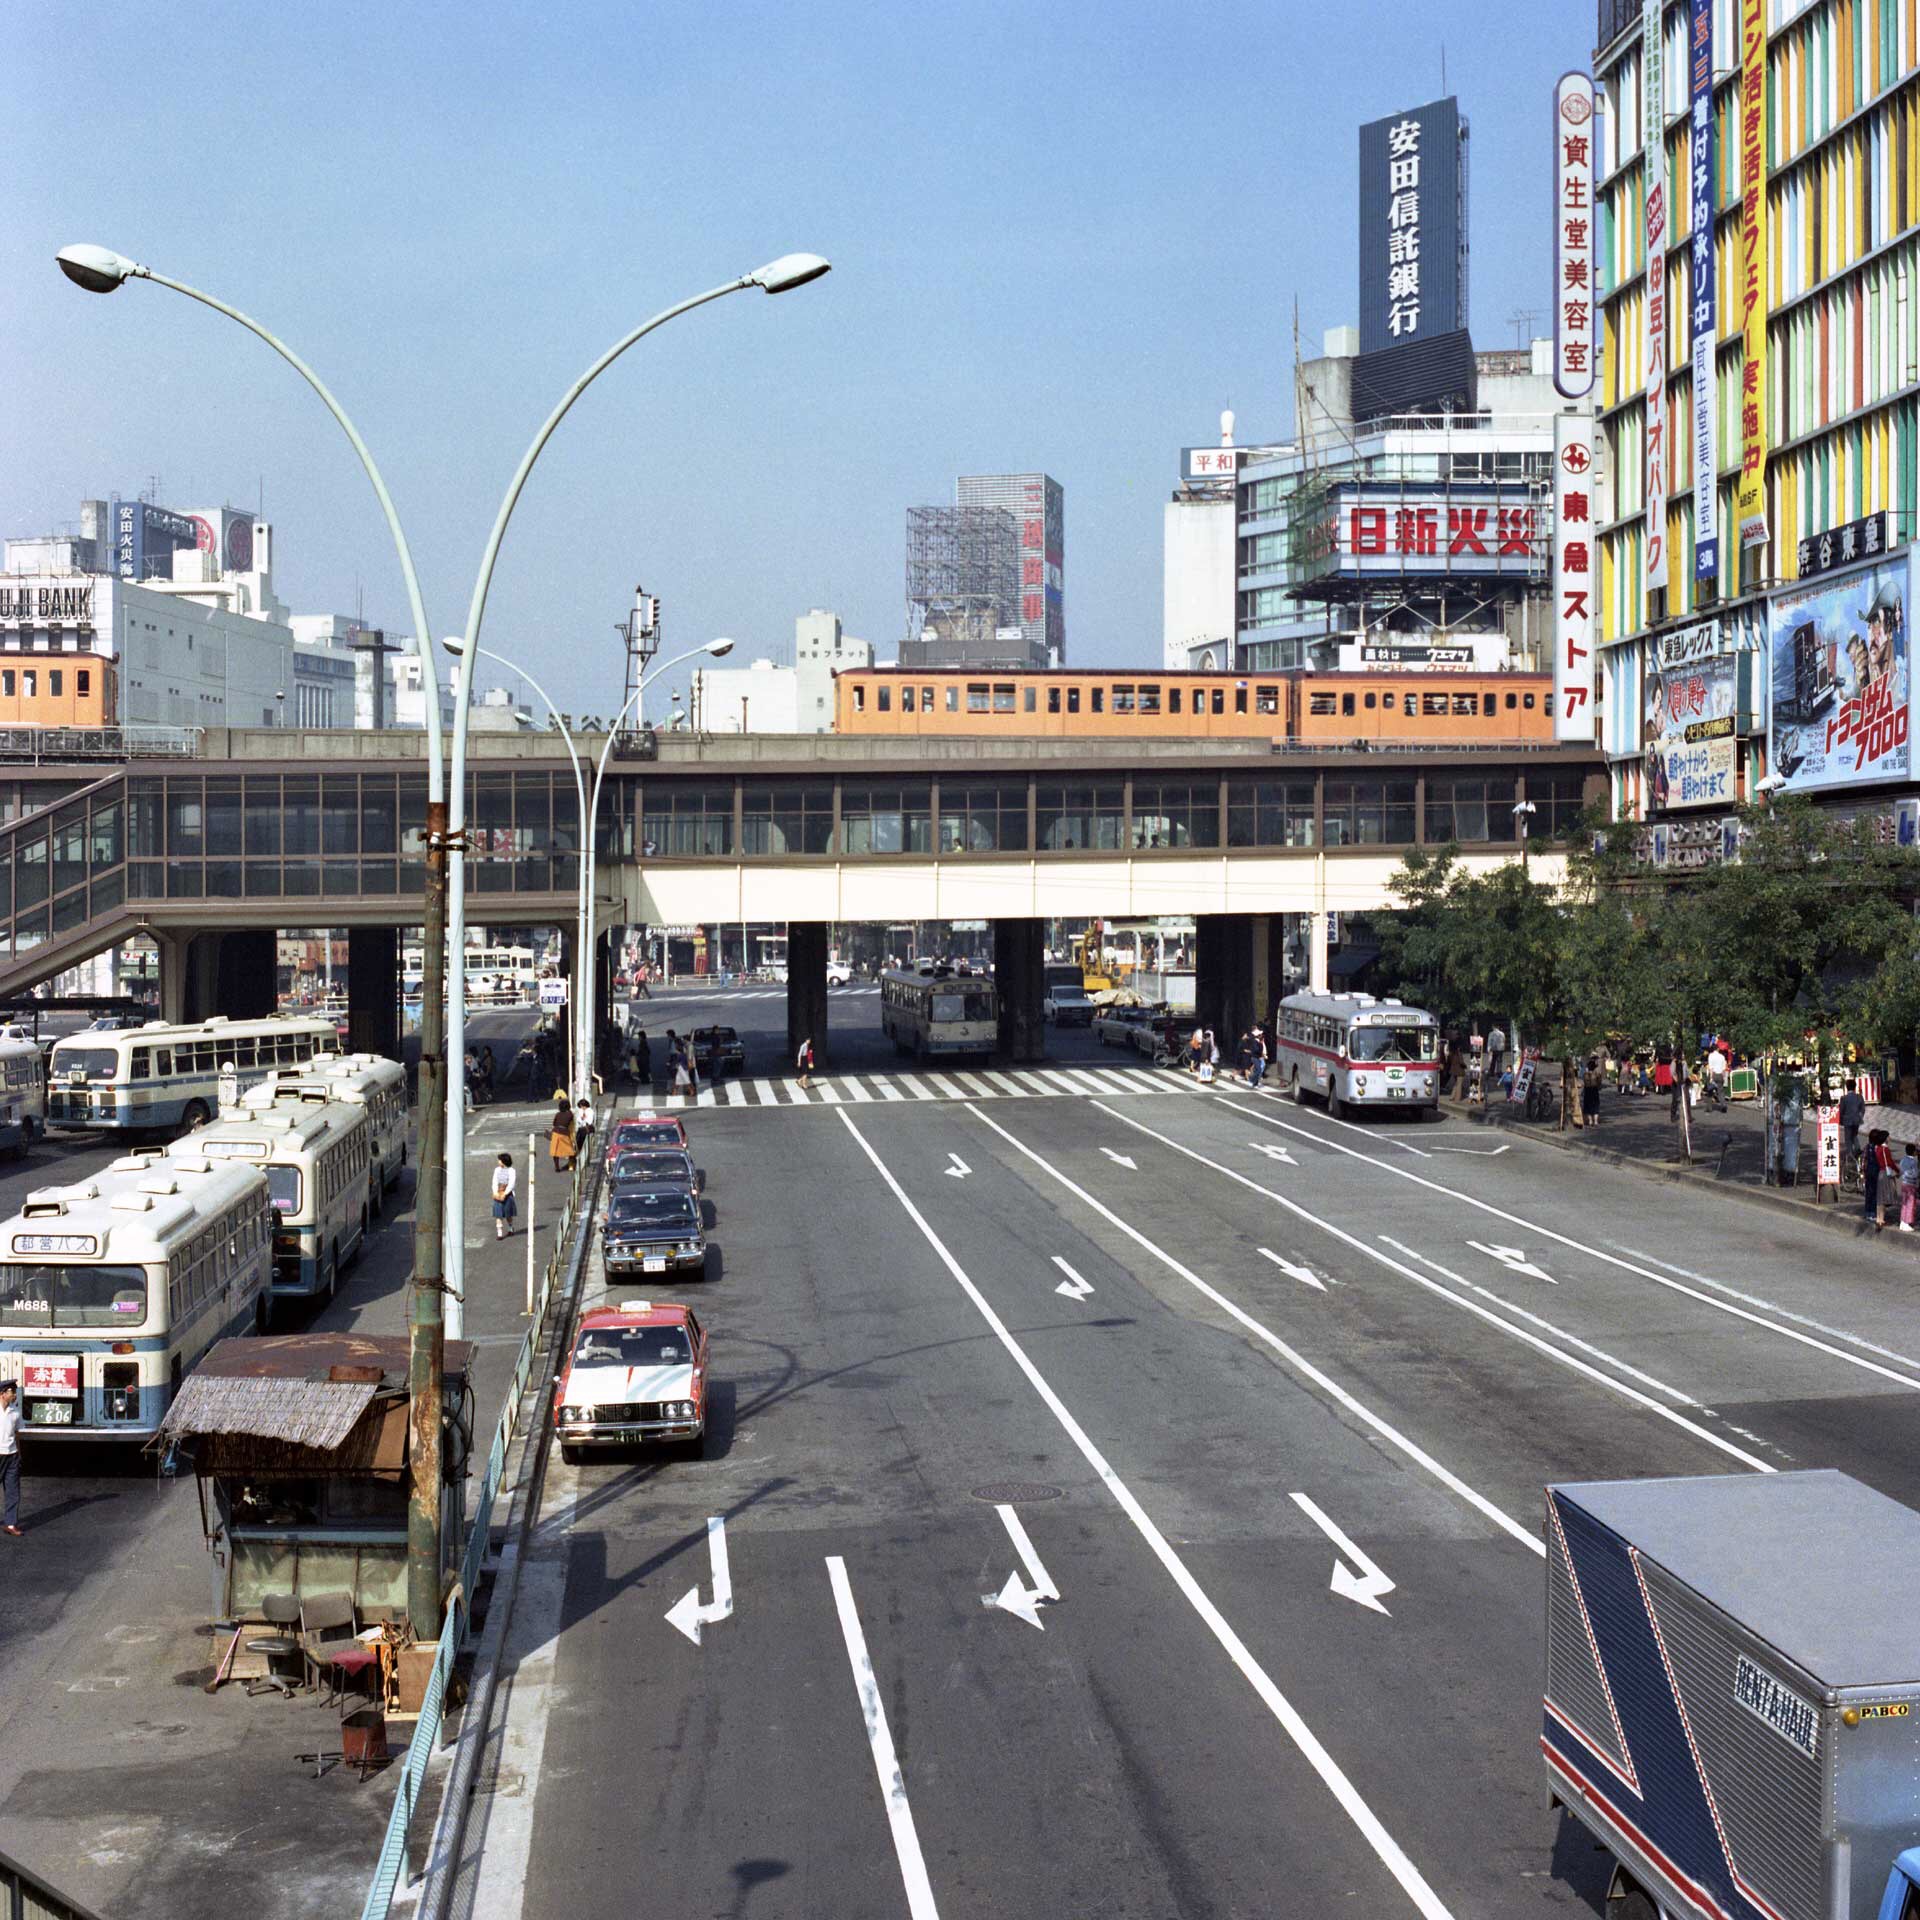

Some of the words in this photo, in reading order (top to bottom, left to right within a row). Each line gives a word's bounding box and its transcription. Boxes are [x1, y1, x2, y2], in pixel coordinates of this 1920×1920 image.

[1388, 119, 1421, 337] 安田信託銀行
[1563, 134, 1589, 373] 資生堂美容室
[1350, 508, 1537, 555] 日新火災
[39, 587, 92, 618] BANK
[1563, 491, 1589, 719] 東急ストア
[1664, 625, 1714, 665] 東急レックス
[1825, 672, 1894, 756] トランザム
[1855, 704, 1908, 772] 7000
[1823, 1135, 1838, 1168] 雀荘
[21, 1236, 89, 1251] 都営バス
[13, 1299, 49, 1313] M686
[1861, 1705, 1908, 1718] PABCO
